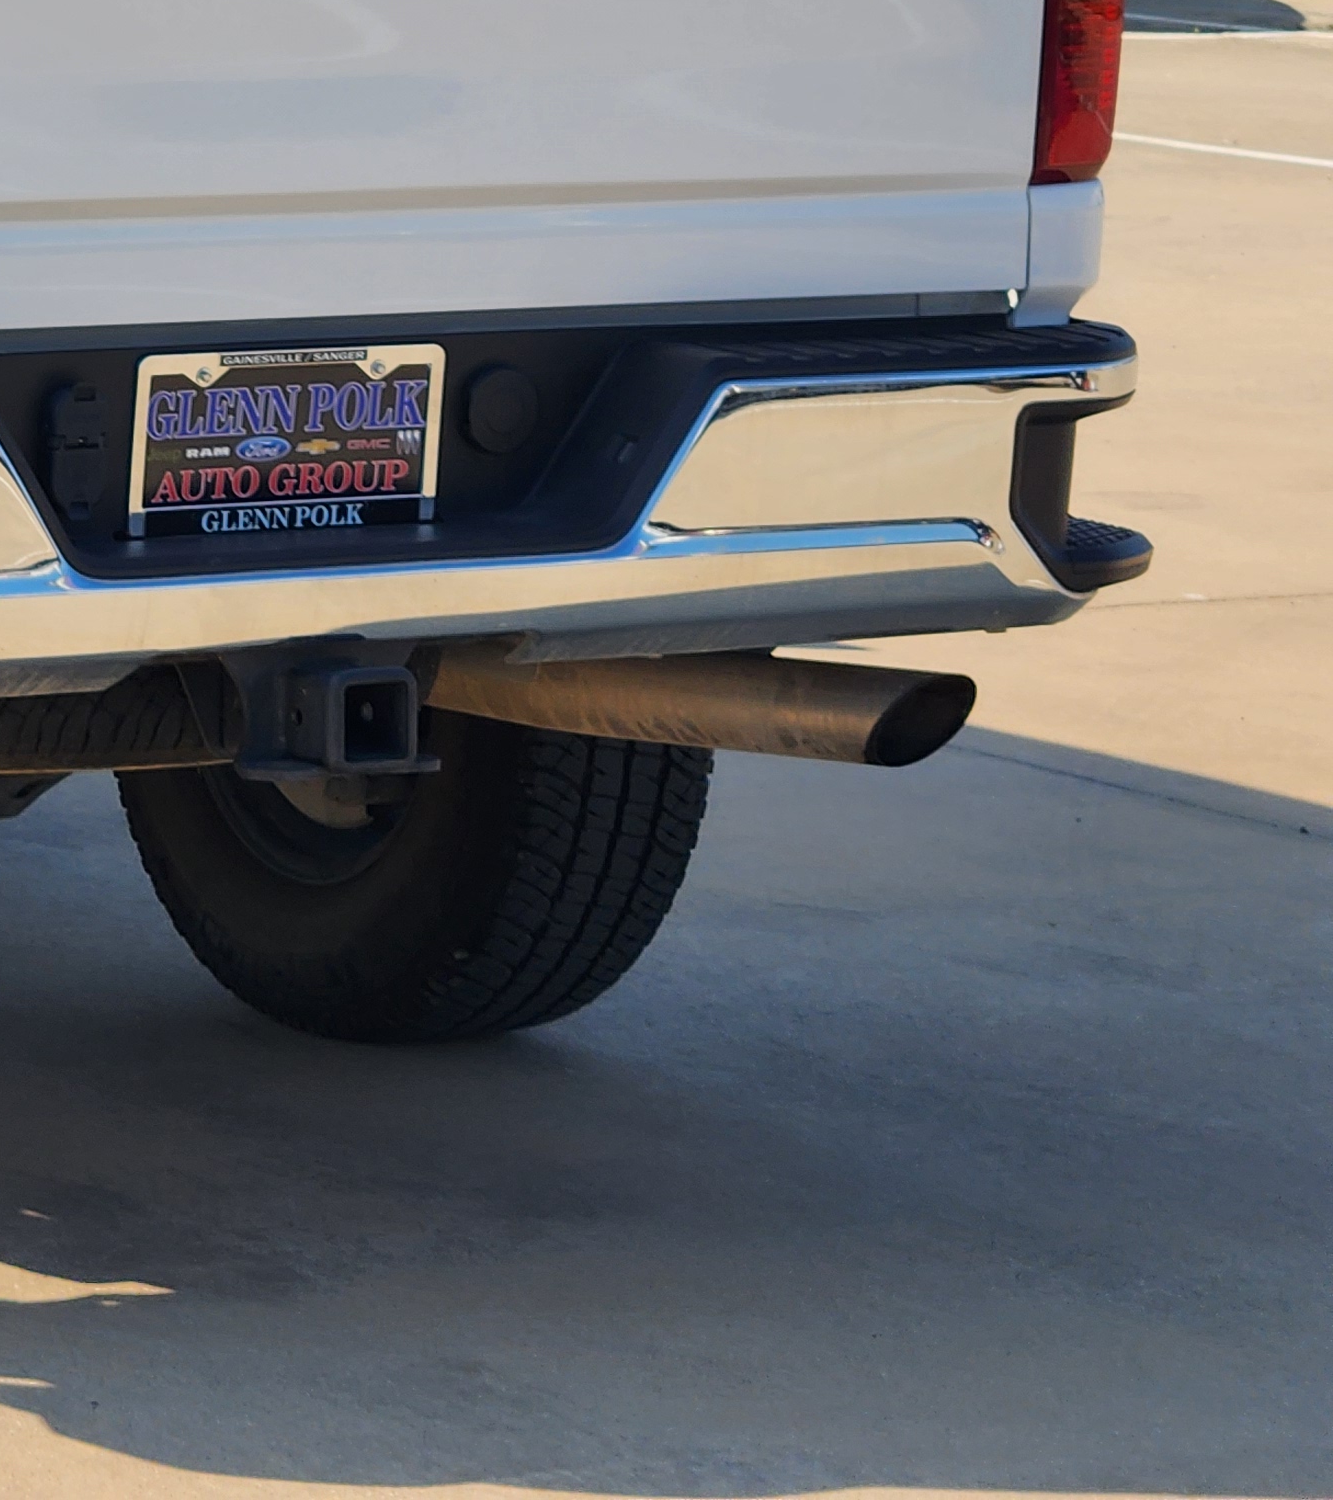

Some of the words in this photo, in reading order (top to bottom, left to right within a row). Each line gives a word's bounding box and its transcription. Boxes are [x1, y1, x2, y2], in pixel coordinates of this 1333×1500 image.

[222, 352, 303, 366] GAINESVILLE
[312, 350, 366, 362] SANGER
[146, 385, 300, 441] GLENN
[304, 379, 429, 433] POLK
[185, 446, 231, 459] RAM
[346, 438, 391, 451] GMC
[151, 462, 260, 504] AUTO
[267, 459, 409, 497] GROUP
[201, 506, 290, 533] GLENN
[295, 503, 364, 528] POLK
